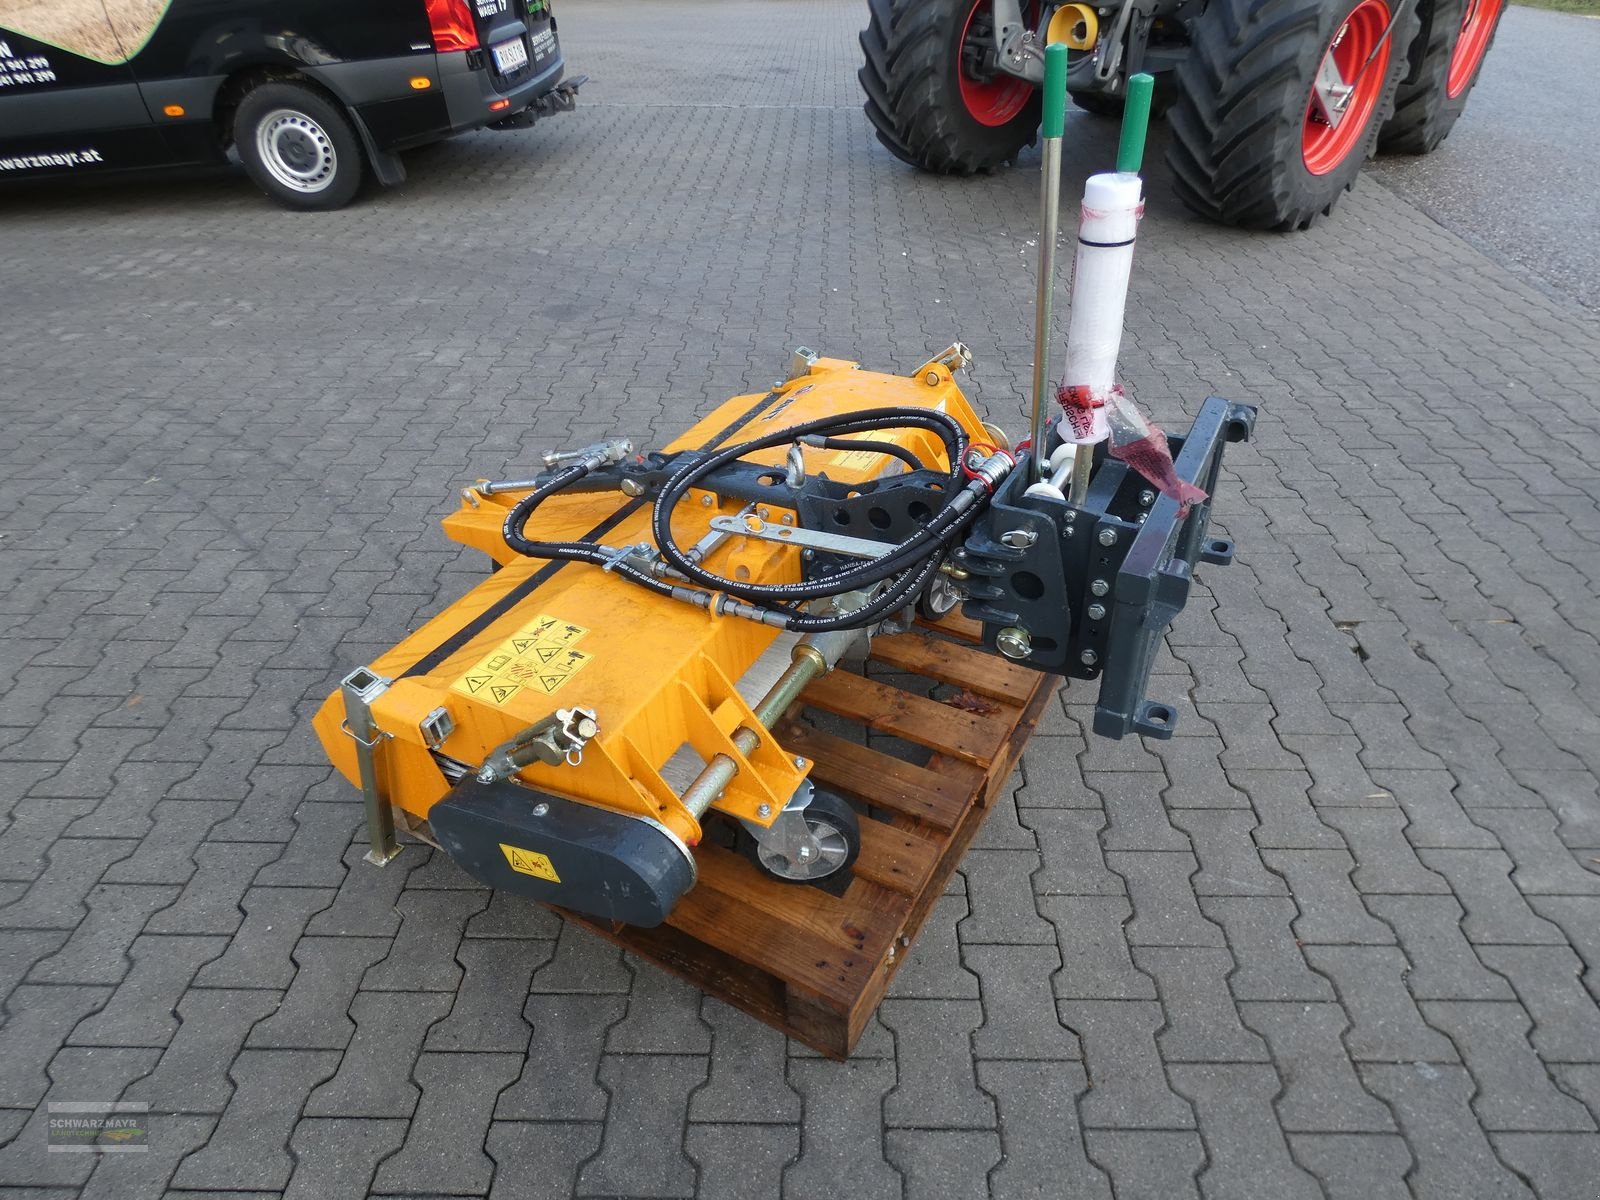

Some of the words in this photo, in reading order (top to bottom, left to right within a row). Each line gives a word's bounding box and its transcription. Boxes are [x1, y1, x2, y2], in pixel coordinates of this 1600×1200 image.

[5, 59, 28, 71] 941
[26, 56, 50, 69] 299
[12, 72, 35, 84] 941
[804, 580, 840, 590] HYDRAULIK
